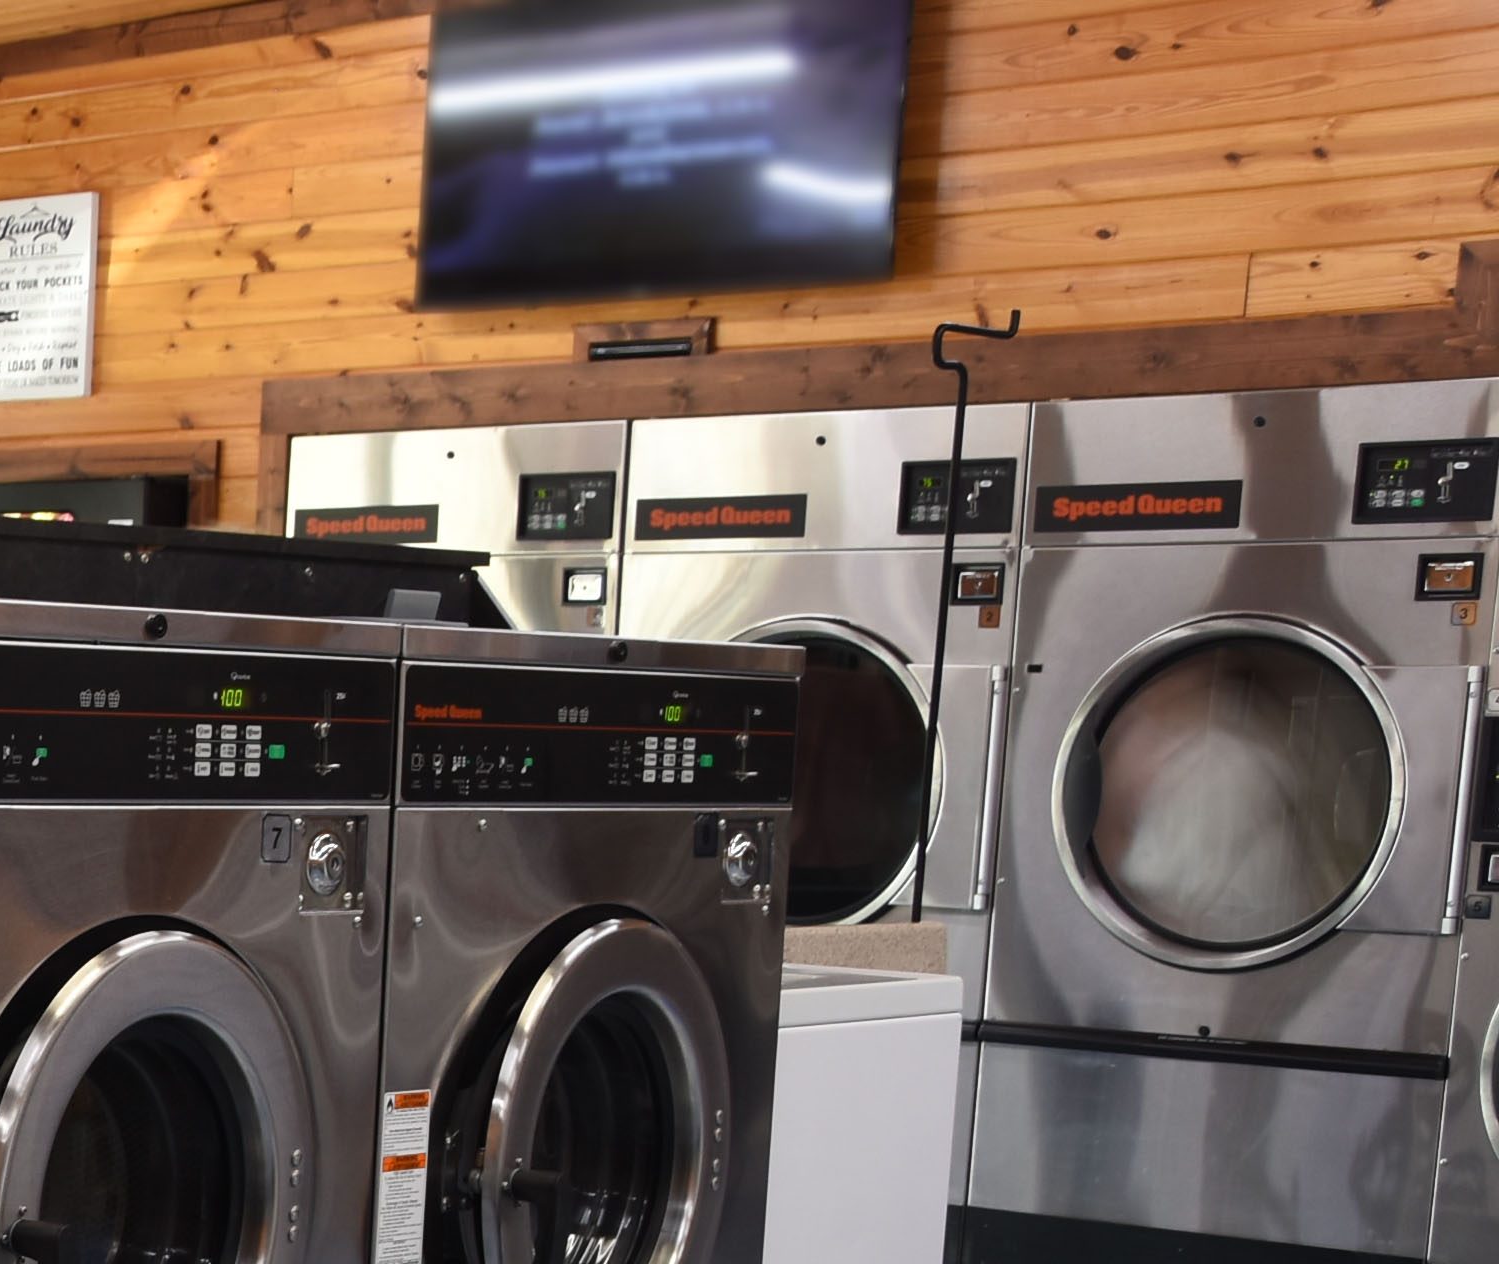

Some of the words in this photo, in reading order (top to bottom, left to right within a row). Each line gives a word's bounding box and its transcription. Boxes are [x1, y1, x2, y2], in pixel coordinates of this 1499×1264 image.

[9, 242, 57, 258] RULES
[17, 279, 38, 290] YOUR
[44, 275, 83, 287] POCKETS
[8, 359, 36, 372] LOADS
[43, 358, 53, 370] OF
[60, 357, 79, 369] FUN
[1053, 495, 1136, 521] Speed
[1137, 494, 1223, 515] Queen
[306, 514, 364, 538] Speed
[366, 514, 427, 533] Queen
[650, 507, 718, 530] Speed
[721, 506, 791, 526] Queen
[987, 611, 993, 622] 2
[1459, 607, 1468, 619] 3
[415, 704, 448, 720] Speed
[449, 704, 482, 719] Queen
[271, 826, 283, 849] 7
